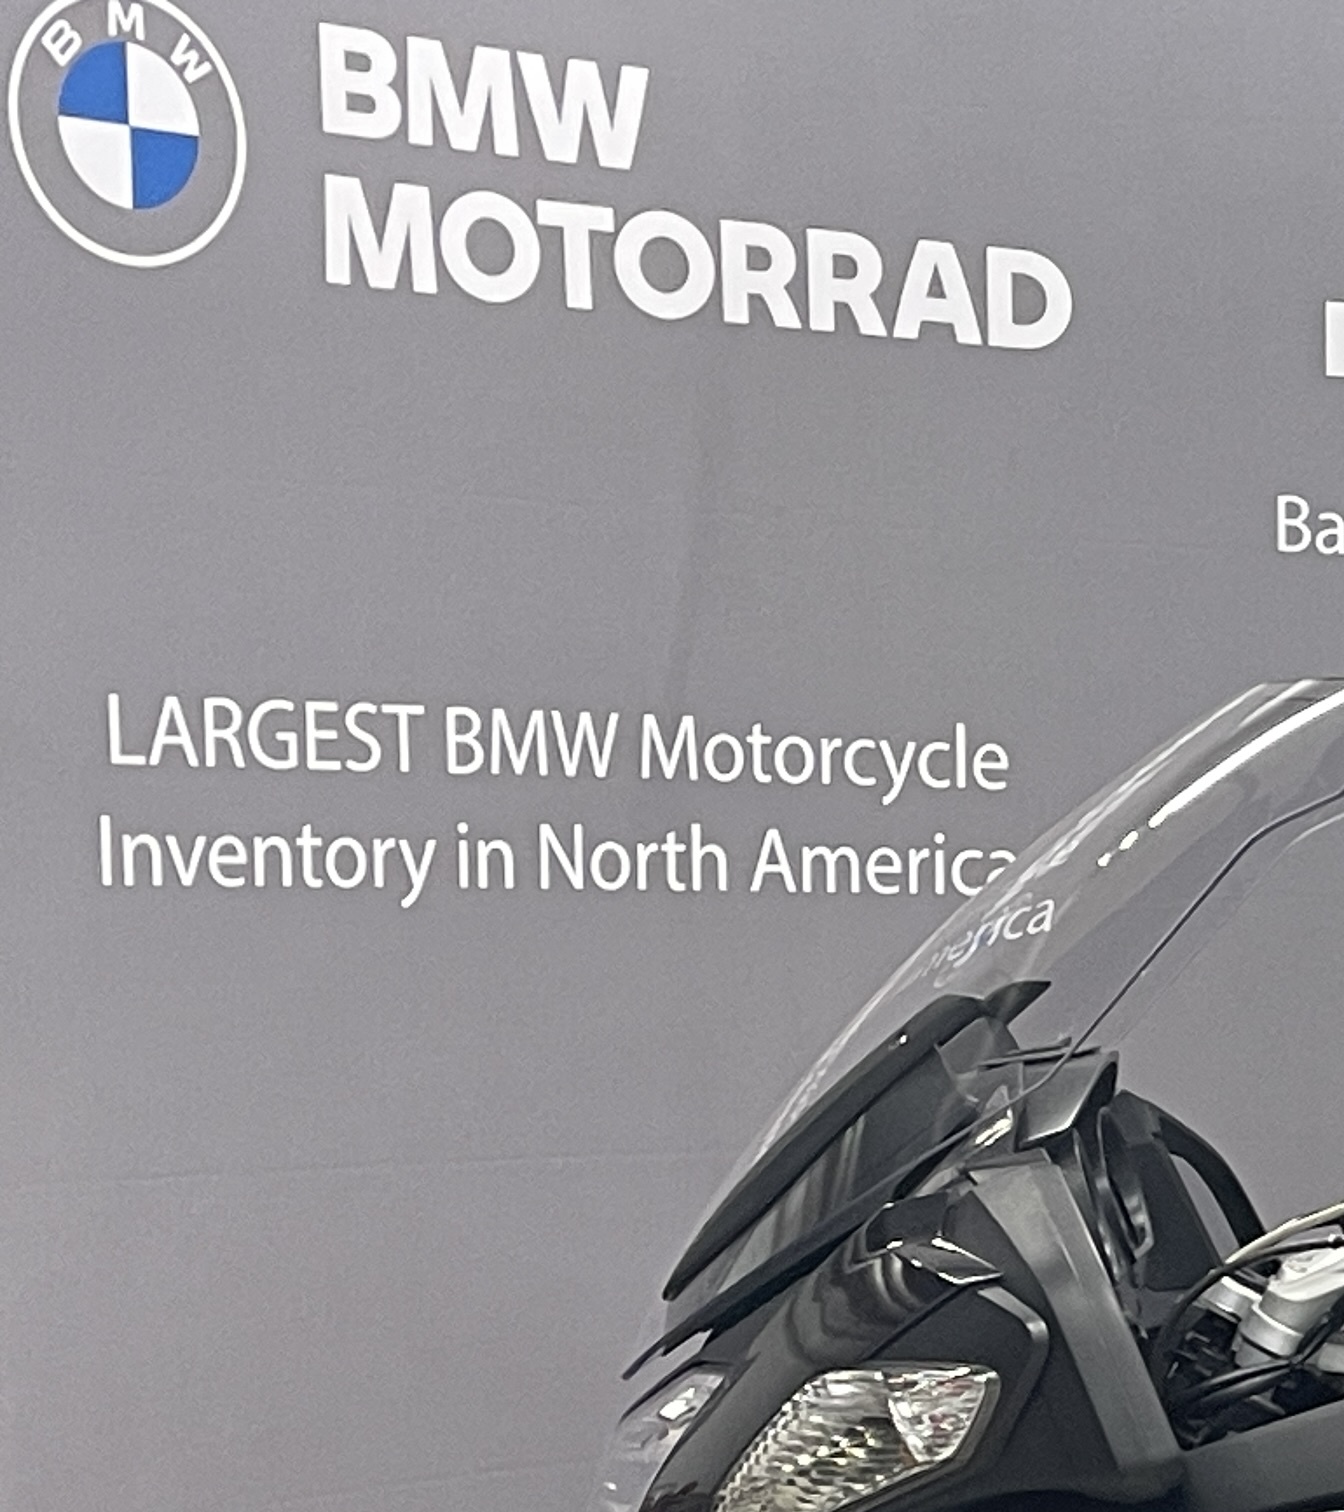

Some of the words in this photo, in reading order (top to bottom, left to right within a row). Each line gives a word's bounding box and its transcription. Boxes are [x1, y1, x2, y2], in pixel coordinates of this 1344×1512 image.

[41, 0, 213, 84] BMW
[319, 23, 649, 169] BMW
[325, 174, 1073, 350] MOTORRAD
[107, 692, 425, 773] LARGEST
[446, 706, 620, 778] BMW
[641, 713, 1010, 806] Motorcycle
[99, 814, 437, 909] Inventory
[457, 821, 515, 890] in
[539, 823, 728, 892] North
